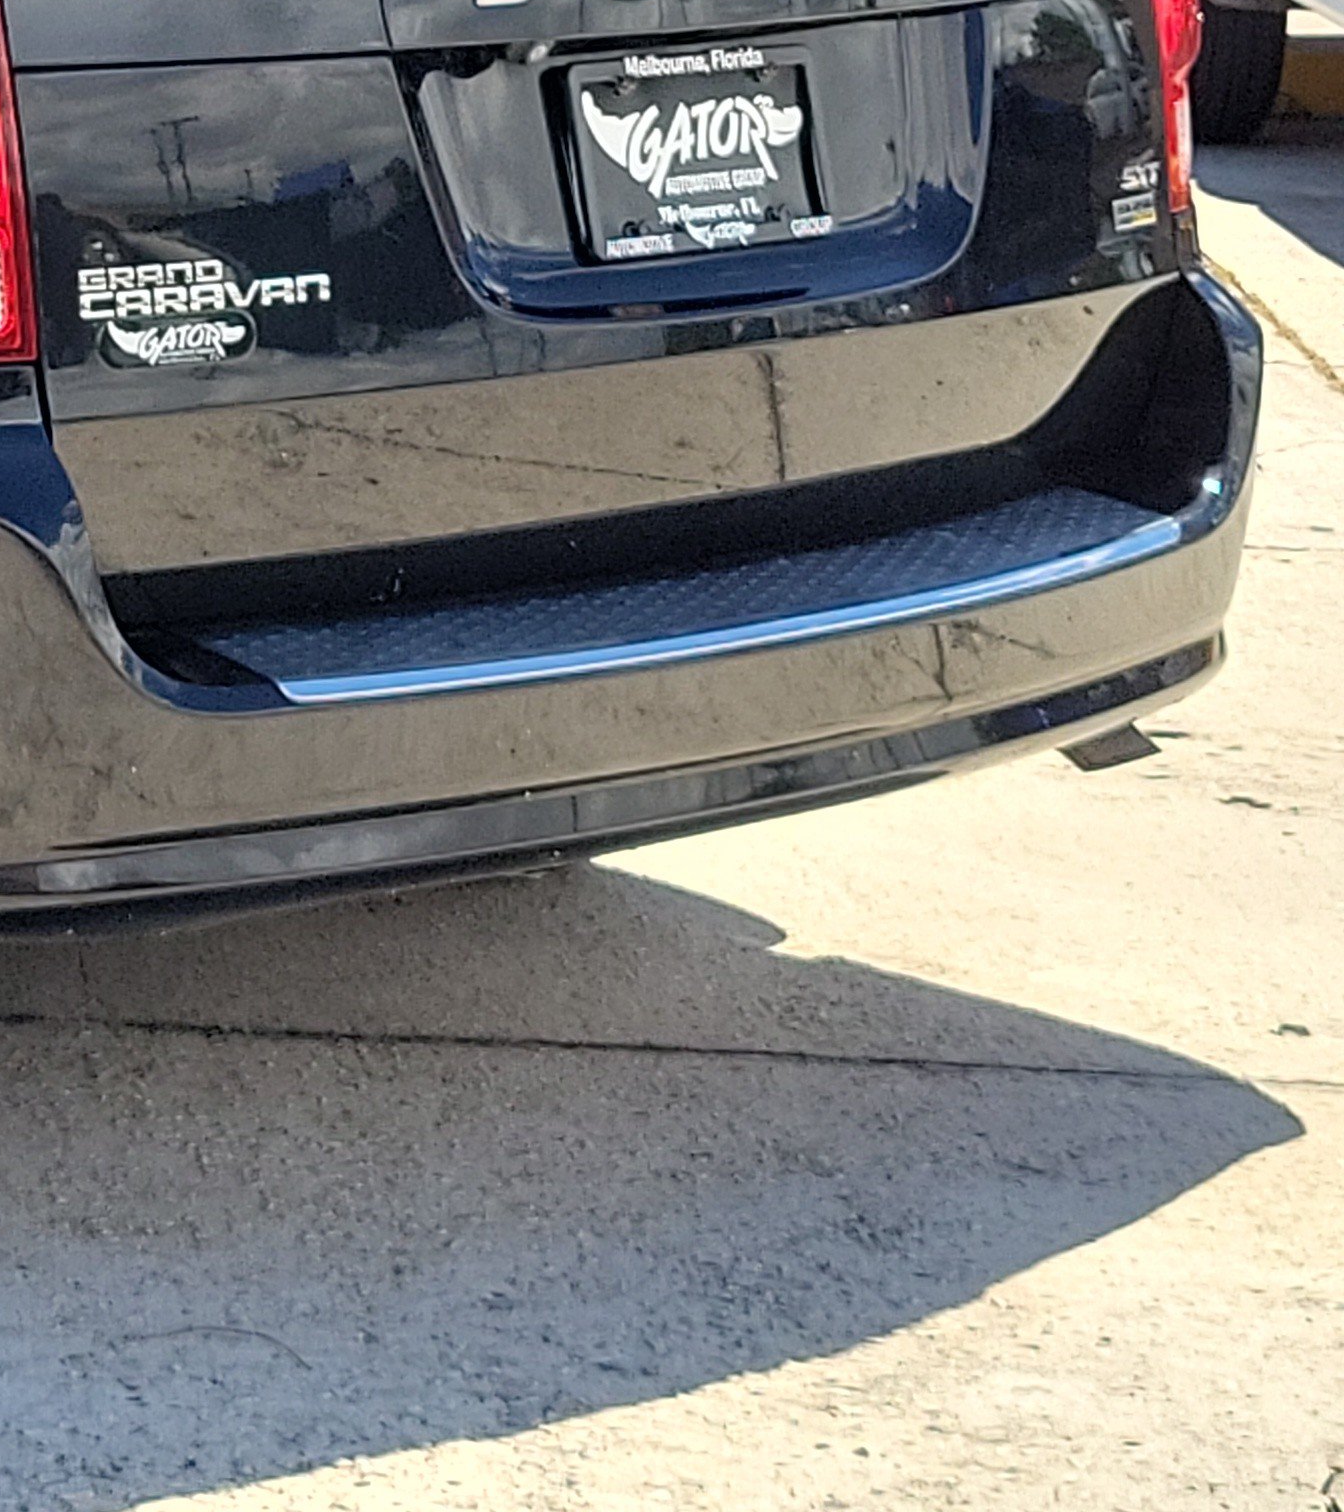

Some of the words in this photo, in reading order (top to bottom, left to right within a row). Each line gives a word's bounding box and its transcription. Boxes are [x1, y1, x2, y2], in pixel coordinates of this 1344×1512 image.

[624, 53, 710, 78] Melbourne,
[711, 47, 764, 70] Florida
[627, 95, 779, 199] GATOR
[78, 258, 223, 292] GRAND
[78, 273, 331, 320] CARAVAN
[138, 322, 226, 366] GATOR
